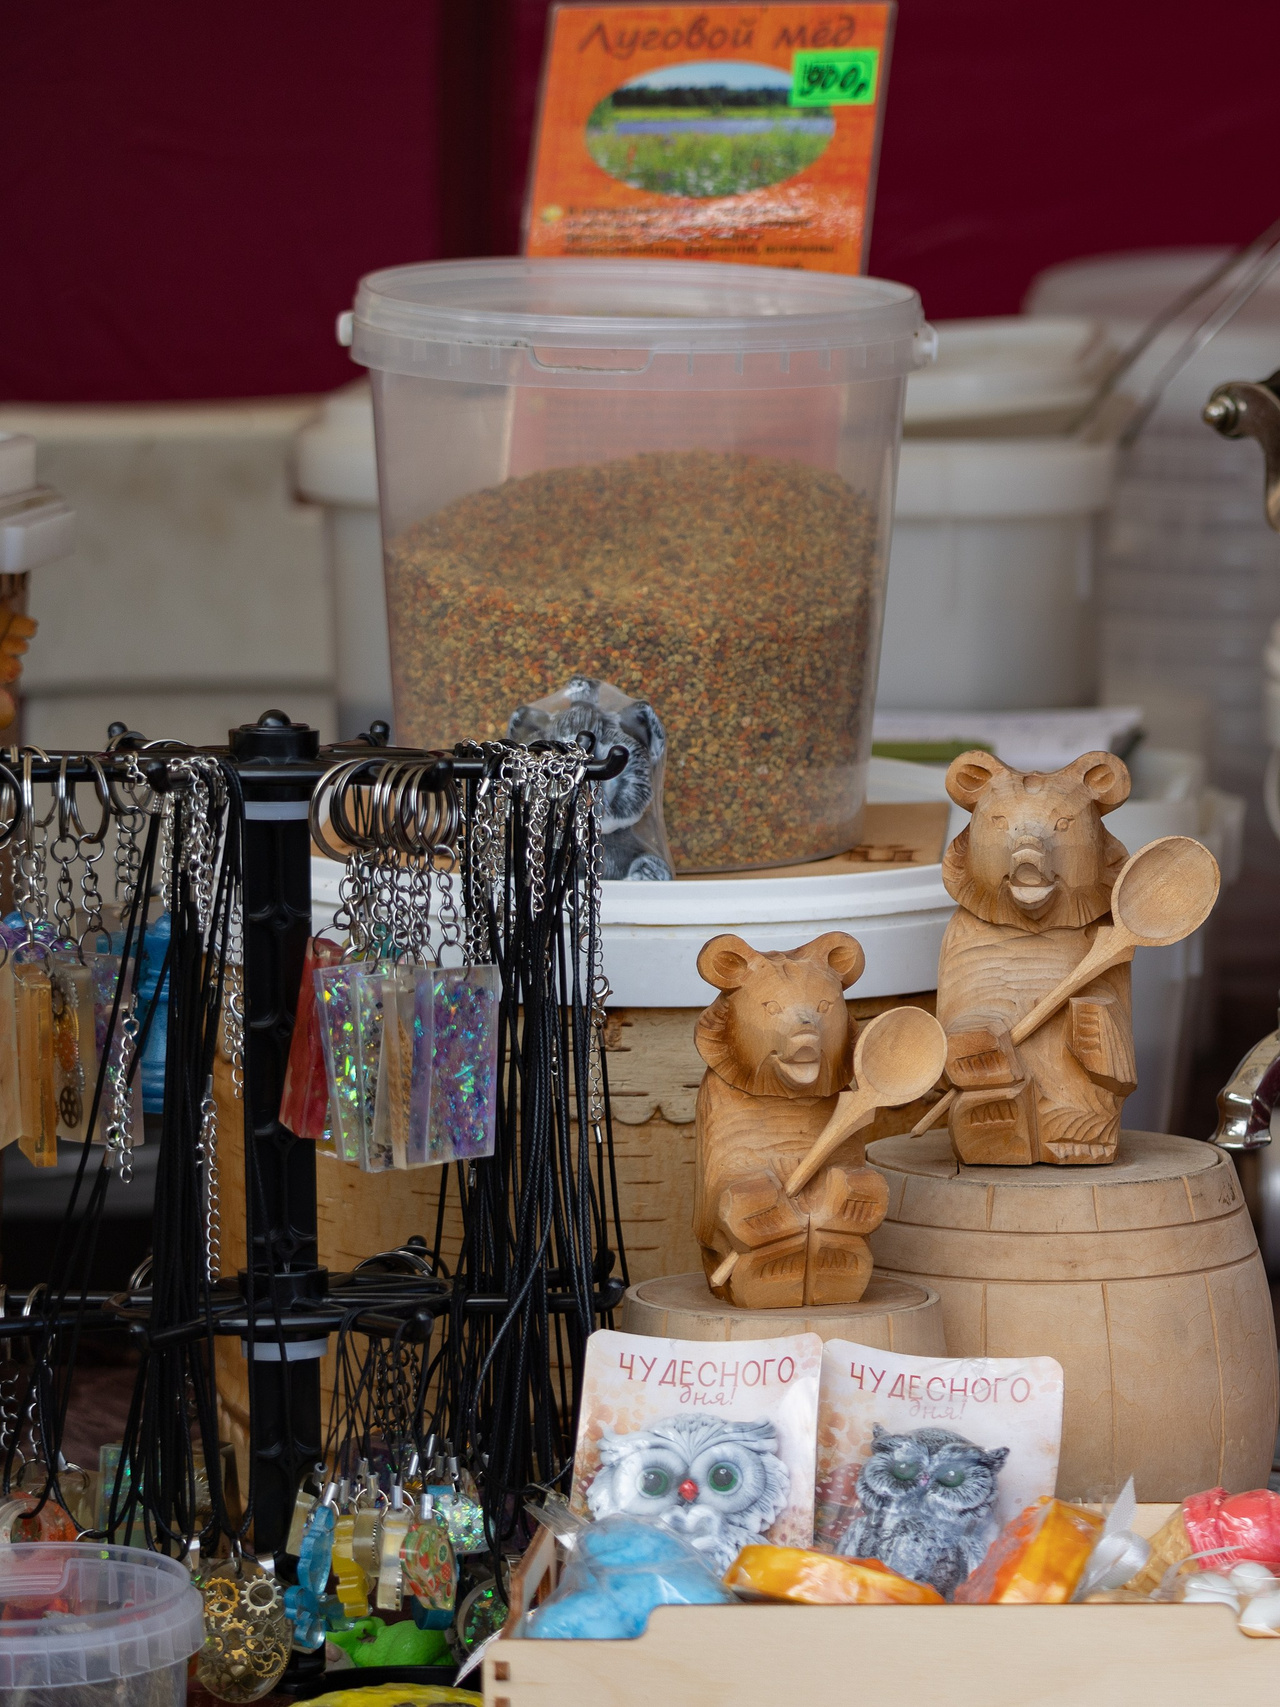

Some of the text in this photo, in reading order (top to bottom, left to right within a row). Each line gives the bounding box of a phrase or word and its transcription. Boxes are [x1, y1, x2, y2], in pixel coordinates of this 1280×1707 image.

[578, 13, 856, 60] Луговой мёд
[619, 1352, 795, 1387] ЧУДЕСНОГО
[850, 1362, 1031, 1404] ЧУДЕСНОГО
[679, 1385, 736, 1406] дня!
[909, 1399, 967, 1420] дня!
